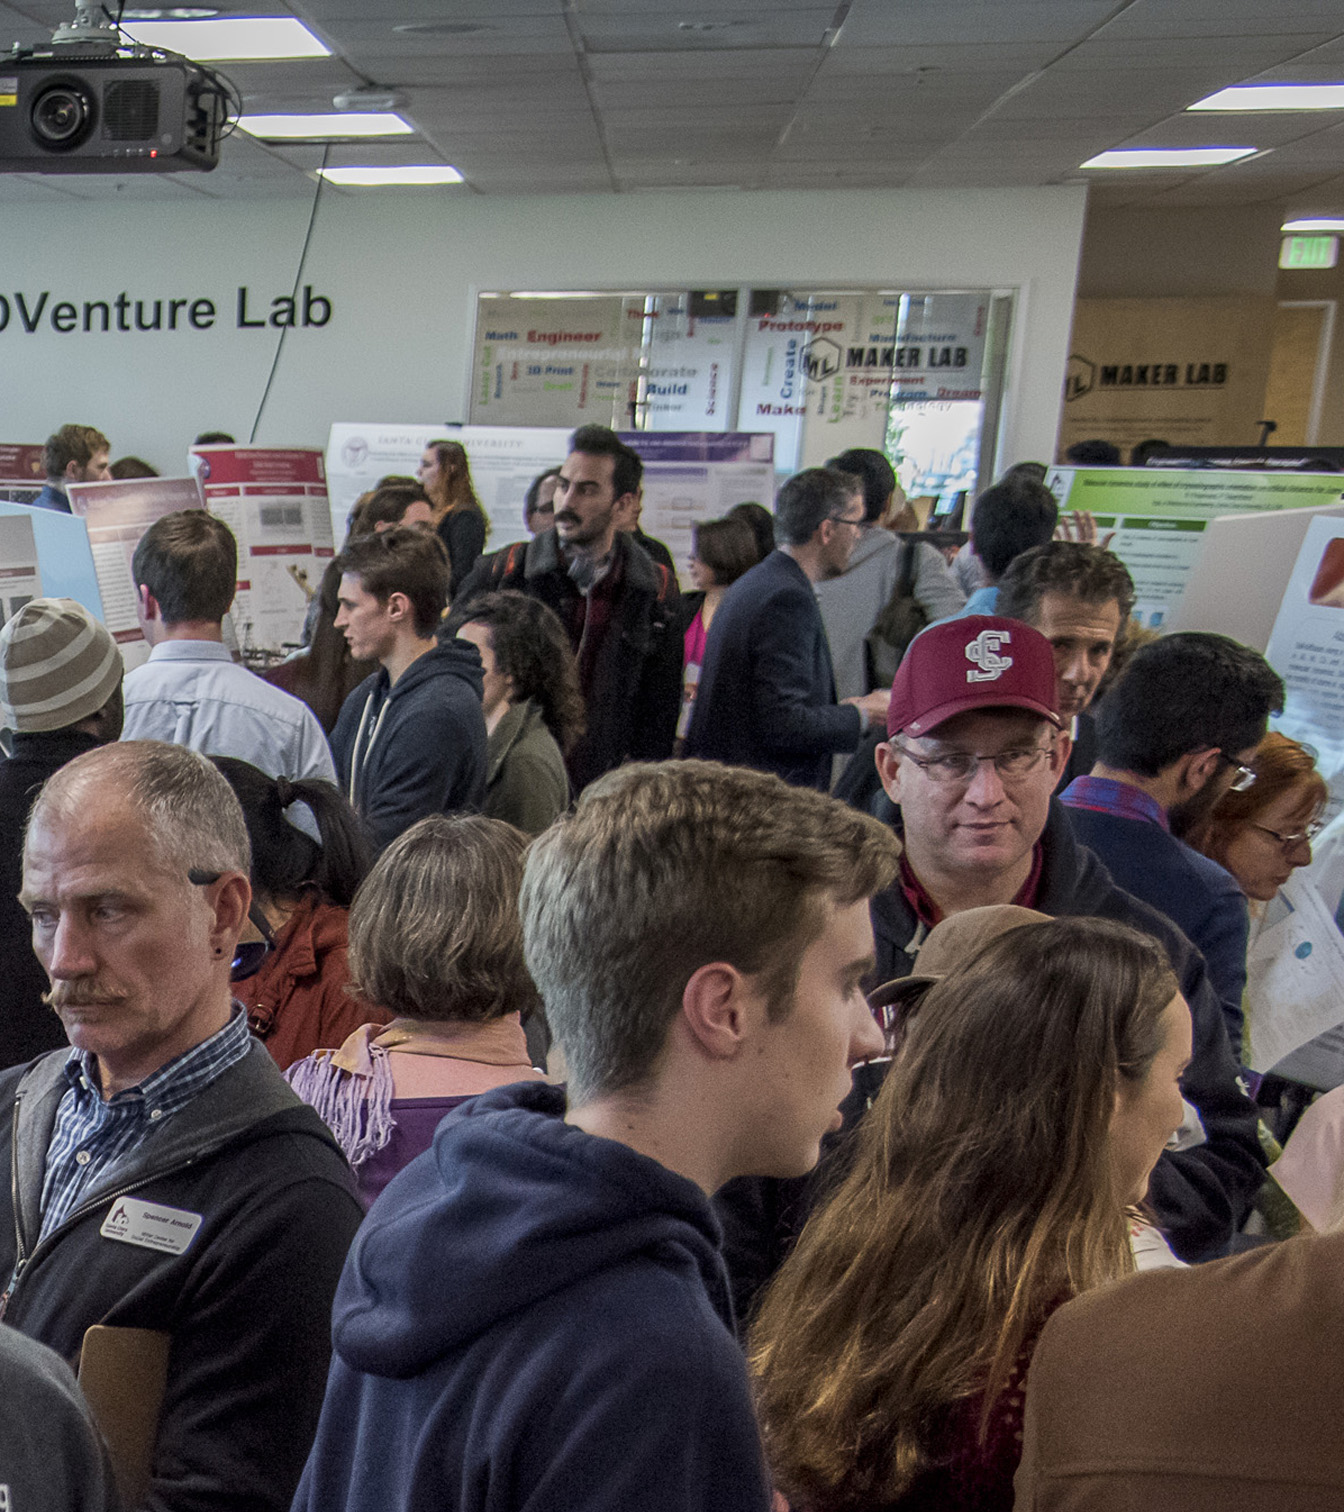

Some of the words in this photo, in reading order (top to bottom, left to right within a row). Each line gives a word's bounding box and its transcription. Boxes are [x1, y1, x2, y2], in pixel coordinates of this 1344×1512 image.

[1288, 236, 1330, 267] EXIT
[235, 285, 333, 331] Lab
[758, 320, 844, 335] Prototype
[527, 330, 602, 346] Engineer
[846, 347, 921, 368] MAKER
[927, 347, 969, 368] LAB
[780, 339, 797, 399] Create
[1098, 365, 1180, 387] MAKER
[1186, 363, 1228, 386] LAB
[647, 383, 688, 395] Build
[756, 403, 807, 416] Make
[142, 1211, 169, 1224] Spencer
[171, 1219, 193, 1230] Arnold
